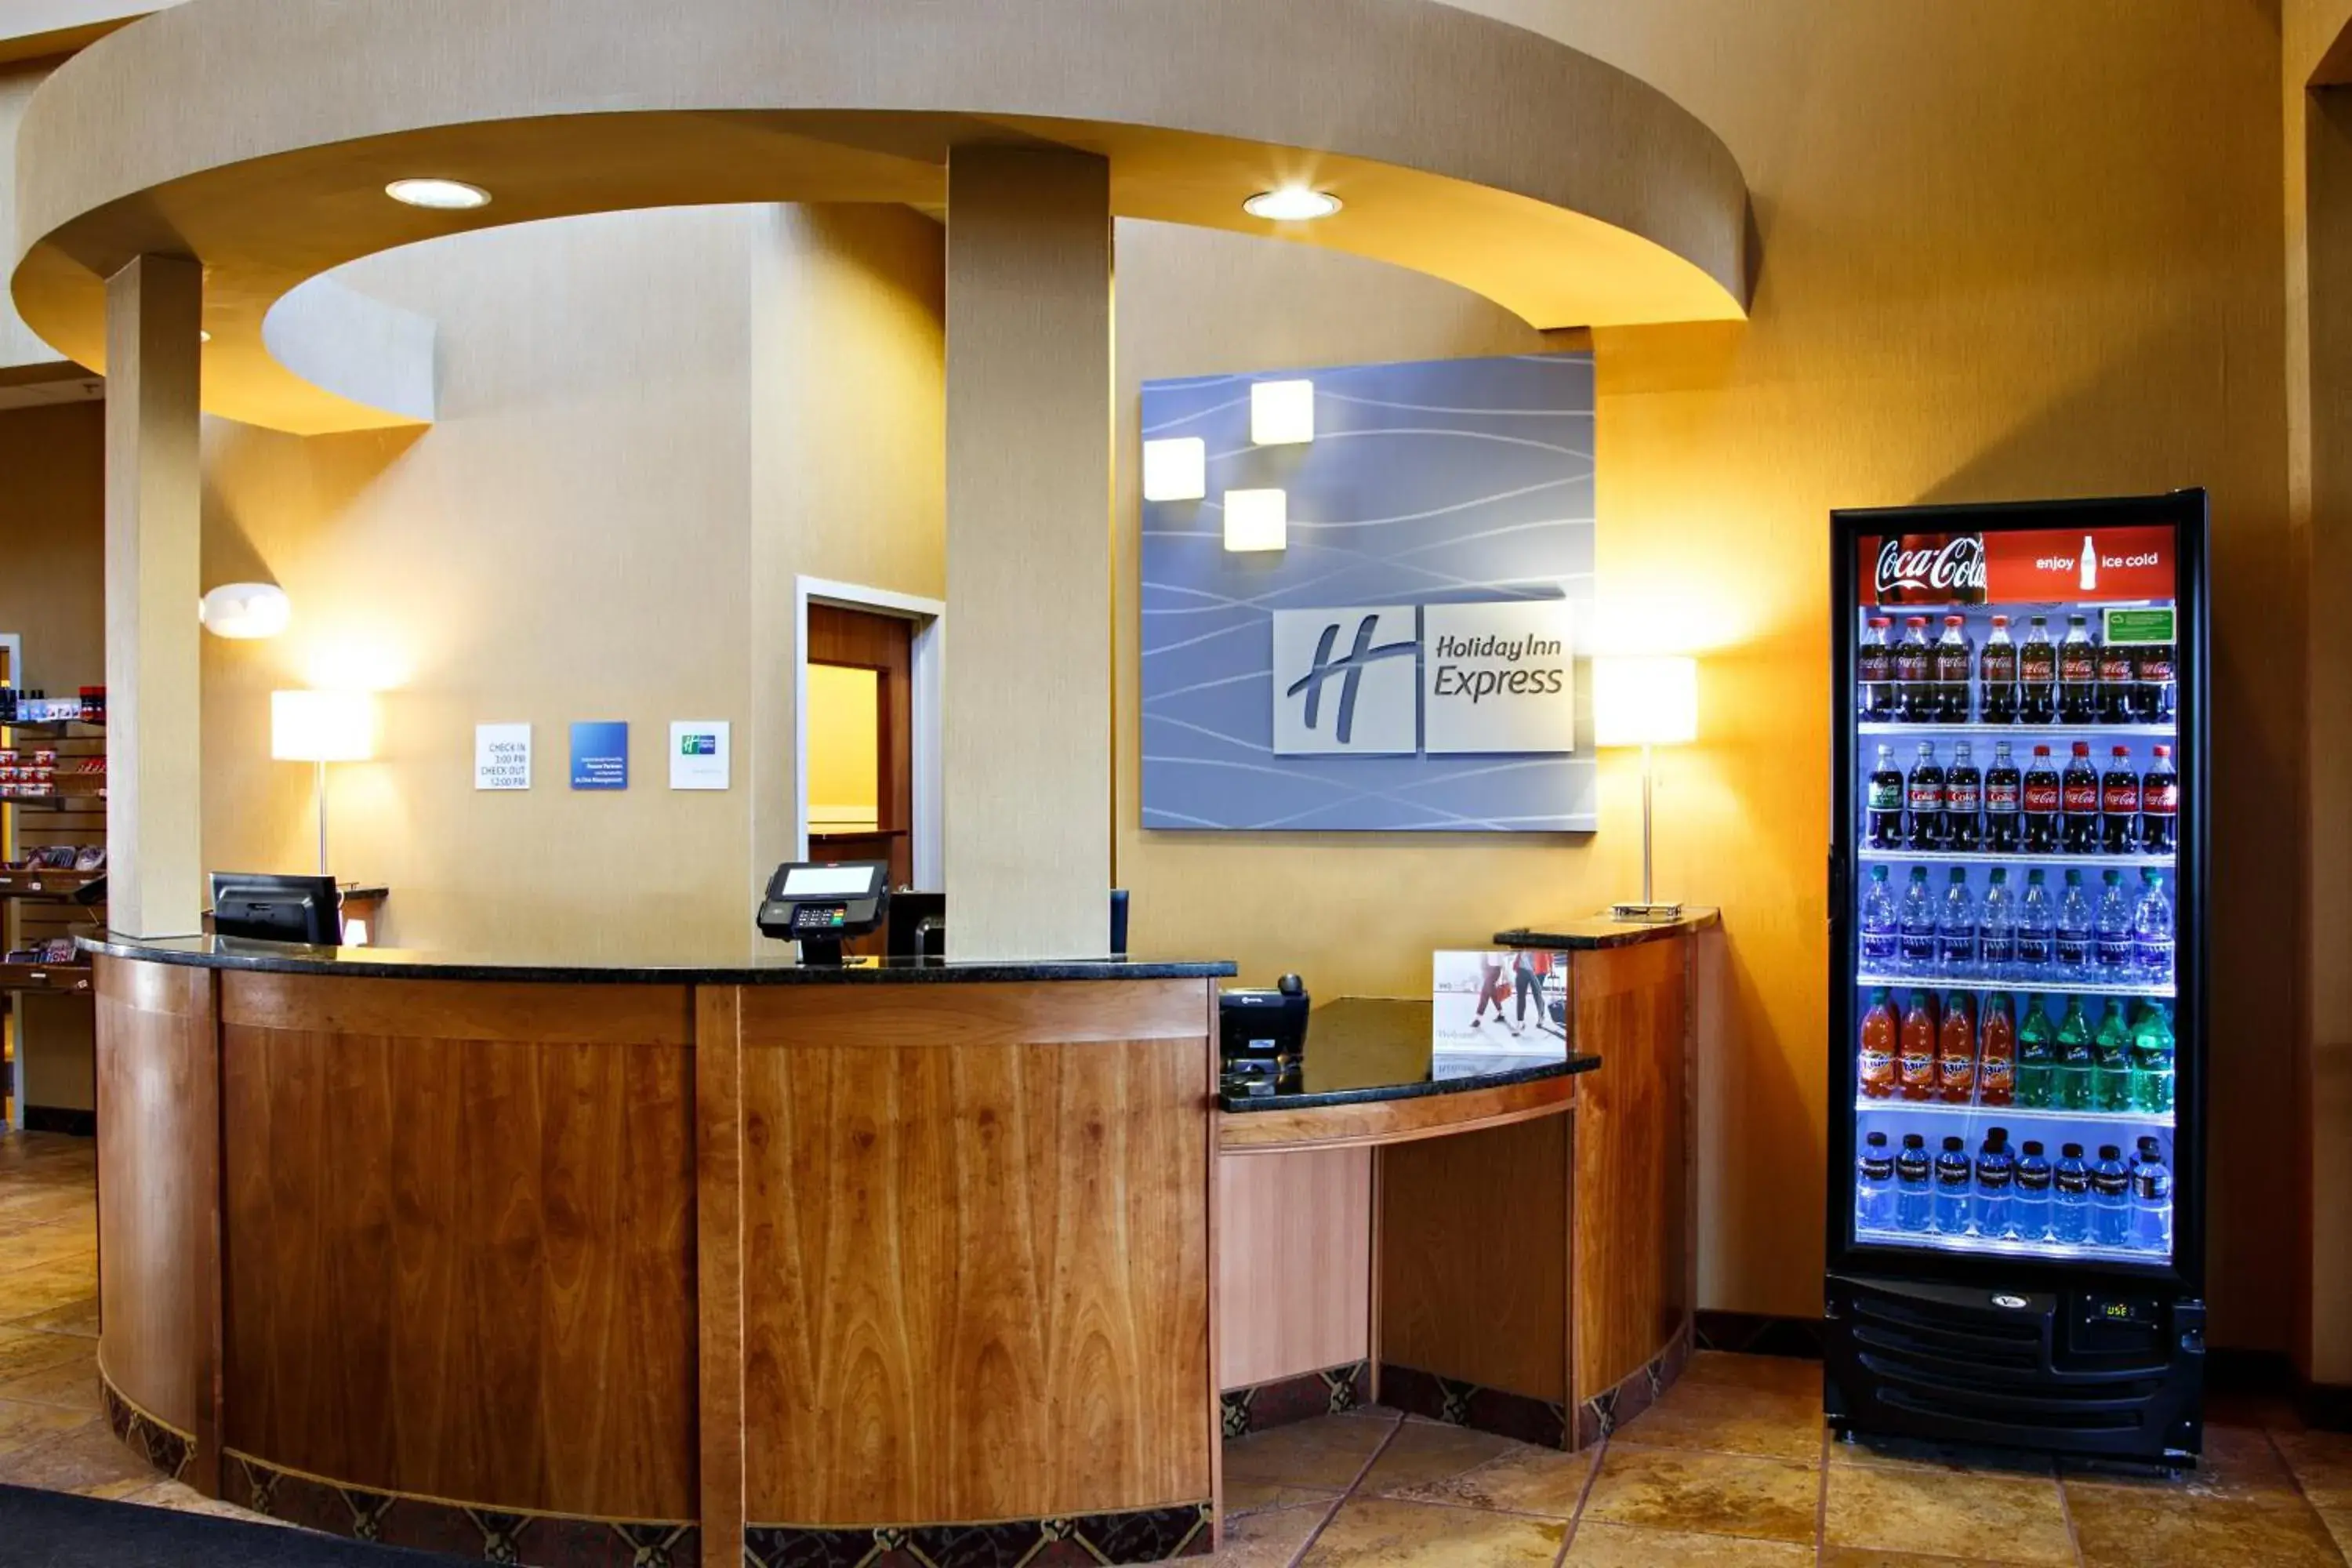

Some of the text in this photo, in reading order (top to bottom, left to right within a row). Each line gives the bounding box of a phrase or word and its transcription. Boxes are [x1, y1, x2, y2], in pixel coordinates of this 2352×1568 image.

[1875, 537, 1987, 592] Coca-Cola
[2036, 552, 2158, 571] enjoy ice cold
[1436, 633, 1562, 662] Holiday Inn
[1434, 664, 1563, 704] Express
[517, 742, 526, 751] IN
[509, 765, 524, 775] OUT
